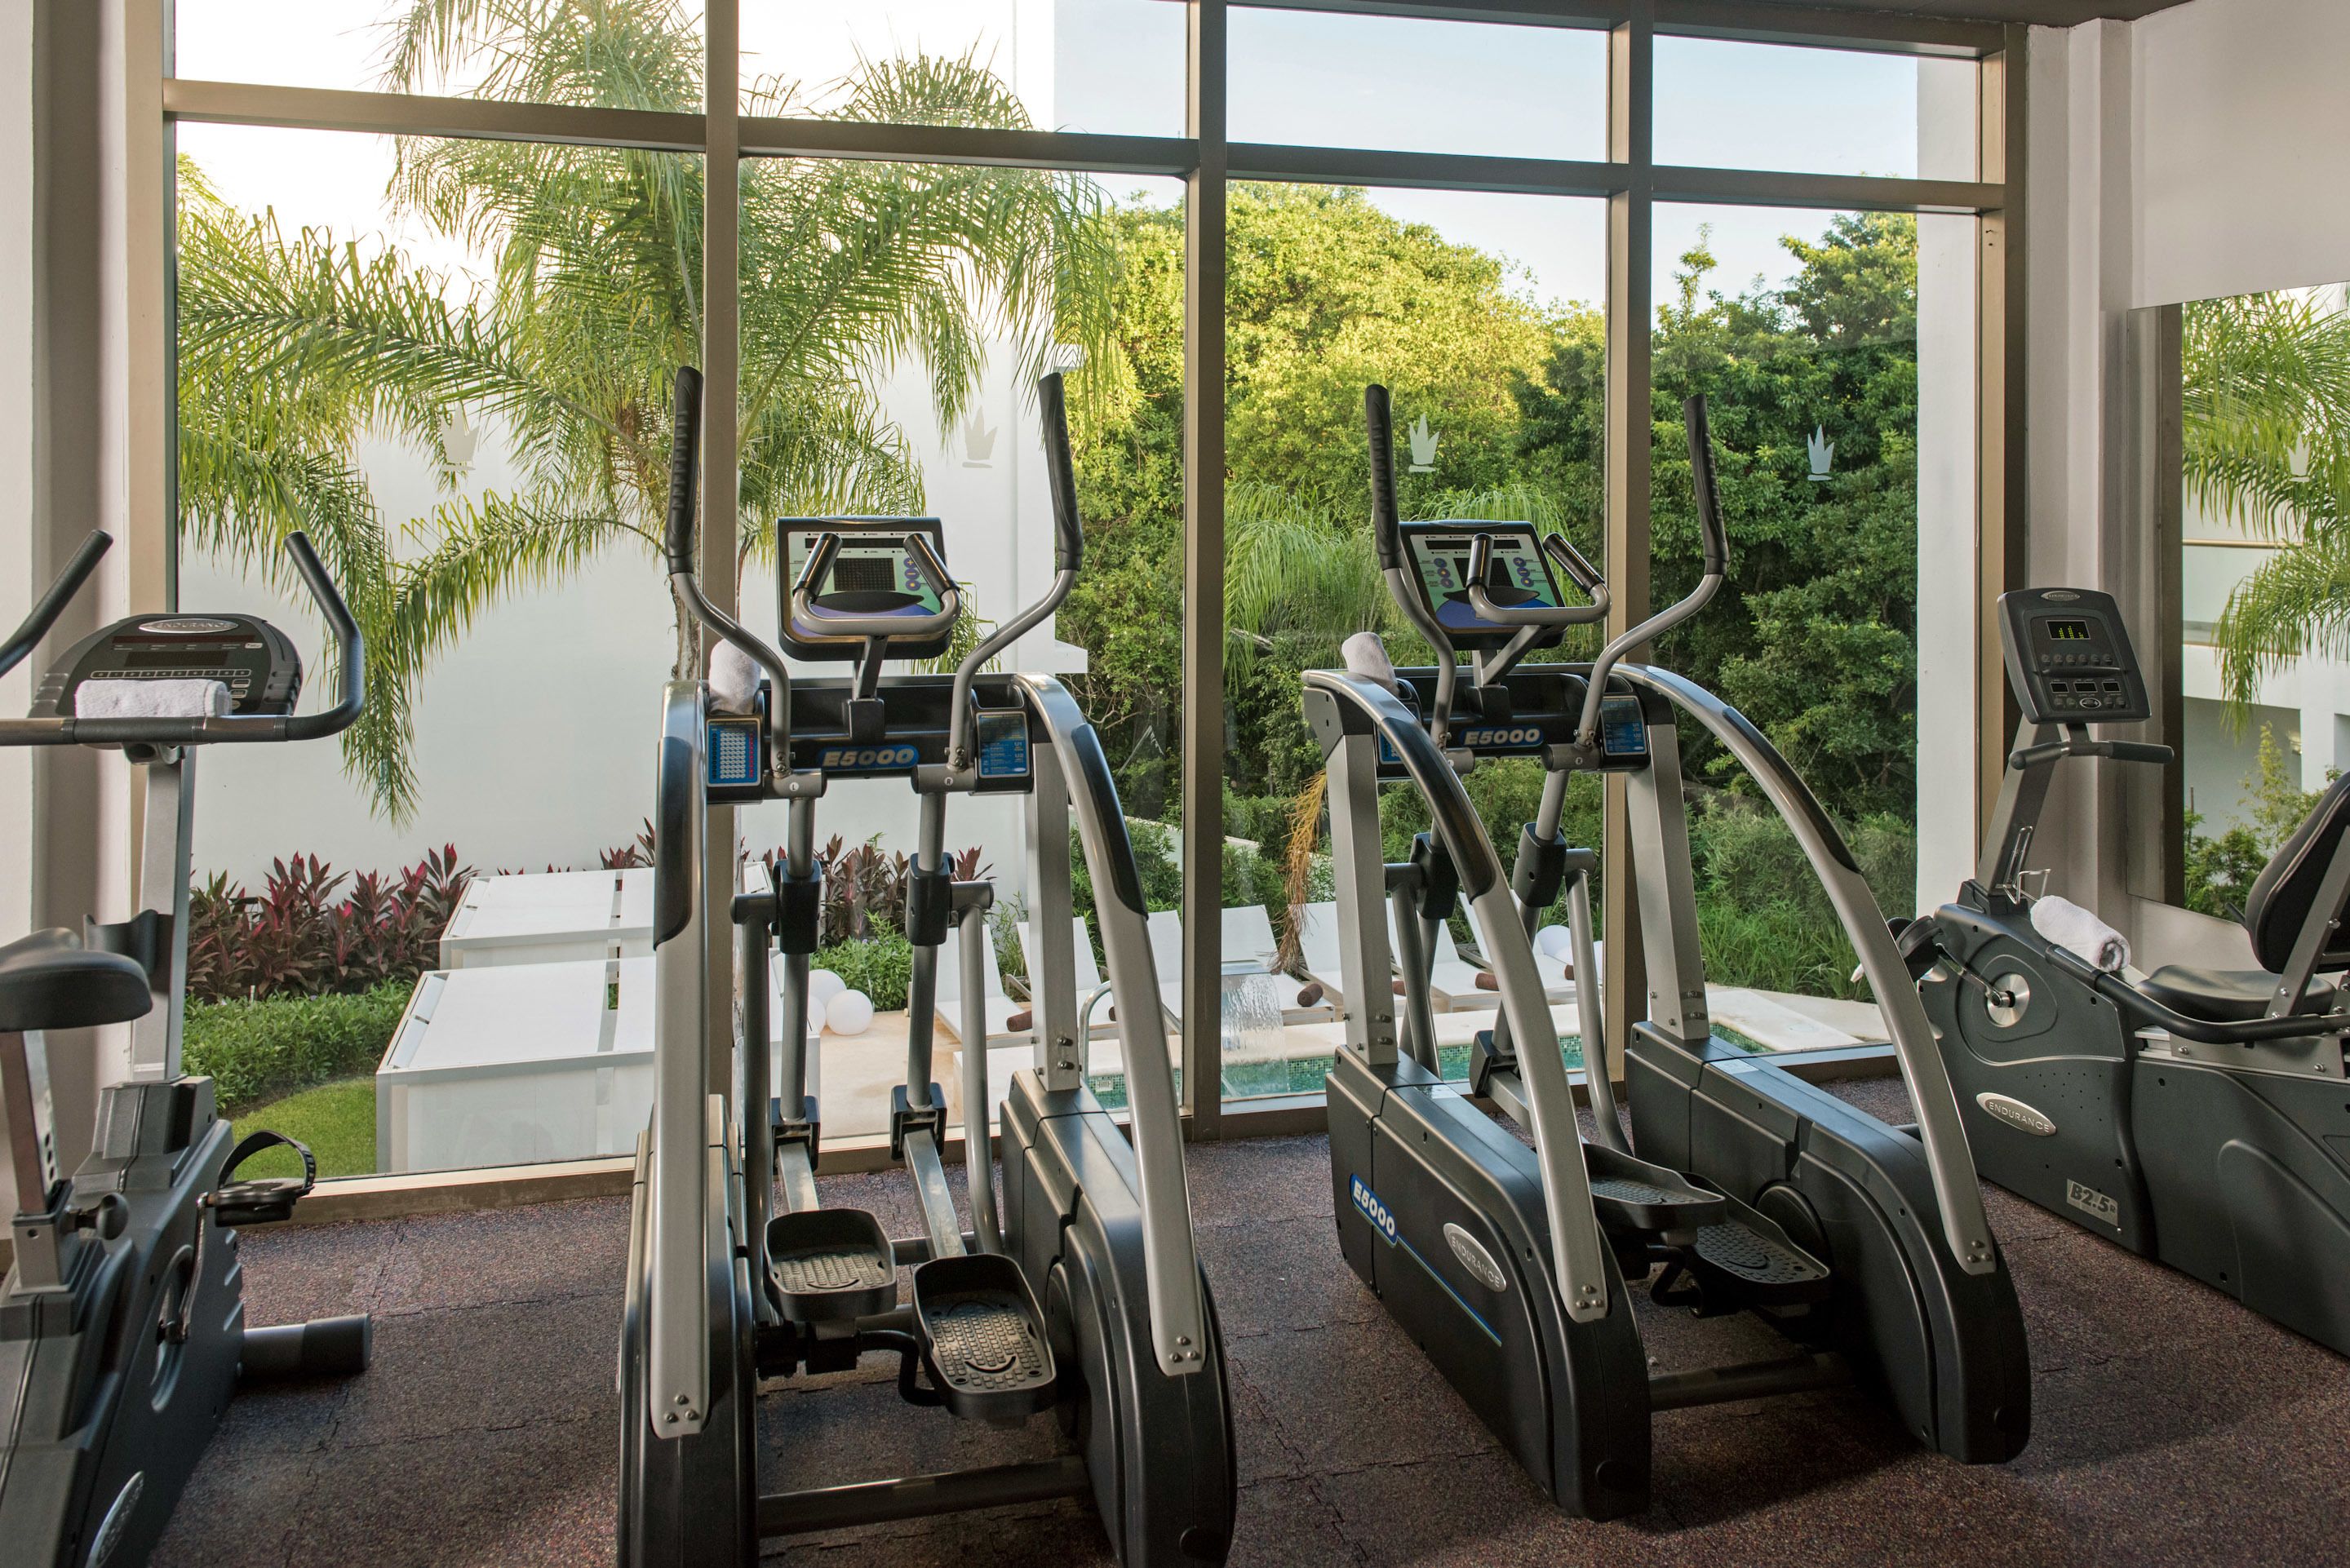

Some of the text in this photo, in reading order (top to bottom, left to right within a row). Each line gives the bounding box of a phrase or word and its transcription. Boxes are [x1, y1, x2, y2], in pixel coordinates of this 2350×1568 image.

[1463, 729, 1540, 746] E5000
[822, 748, 914, 767] E5000
[1989, 1101, 2050, 1133] ENDURANCE
[1352, 1180, 1395, 1237] E5000
[1452, 1237, 1500, 1288] ENDURANCE
